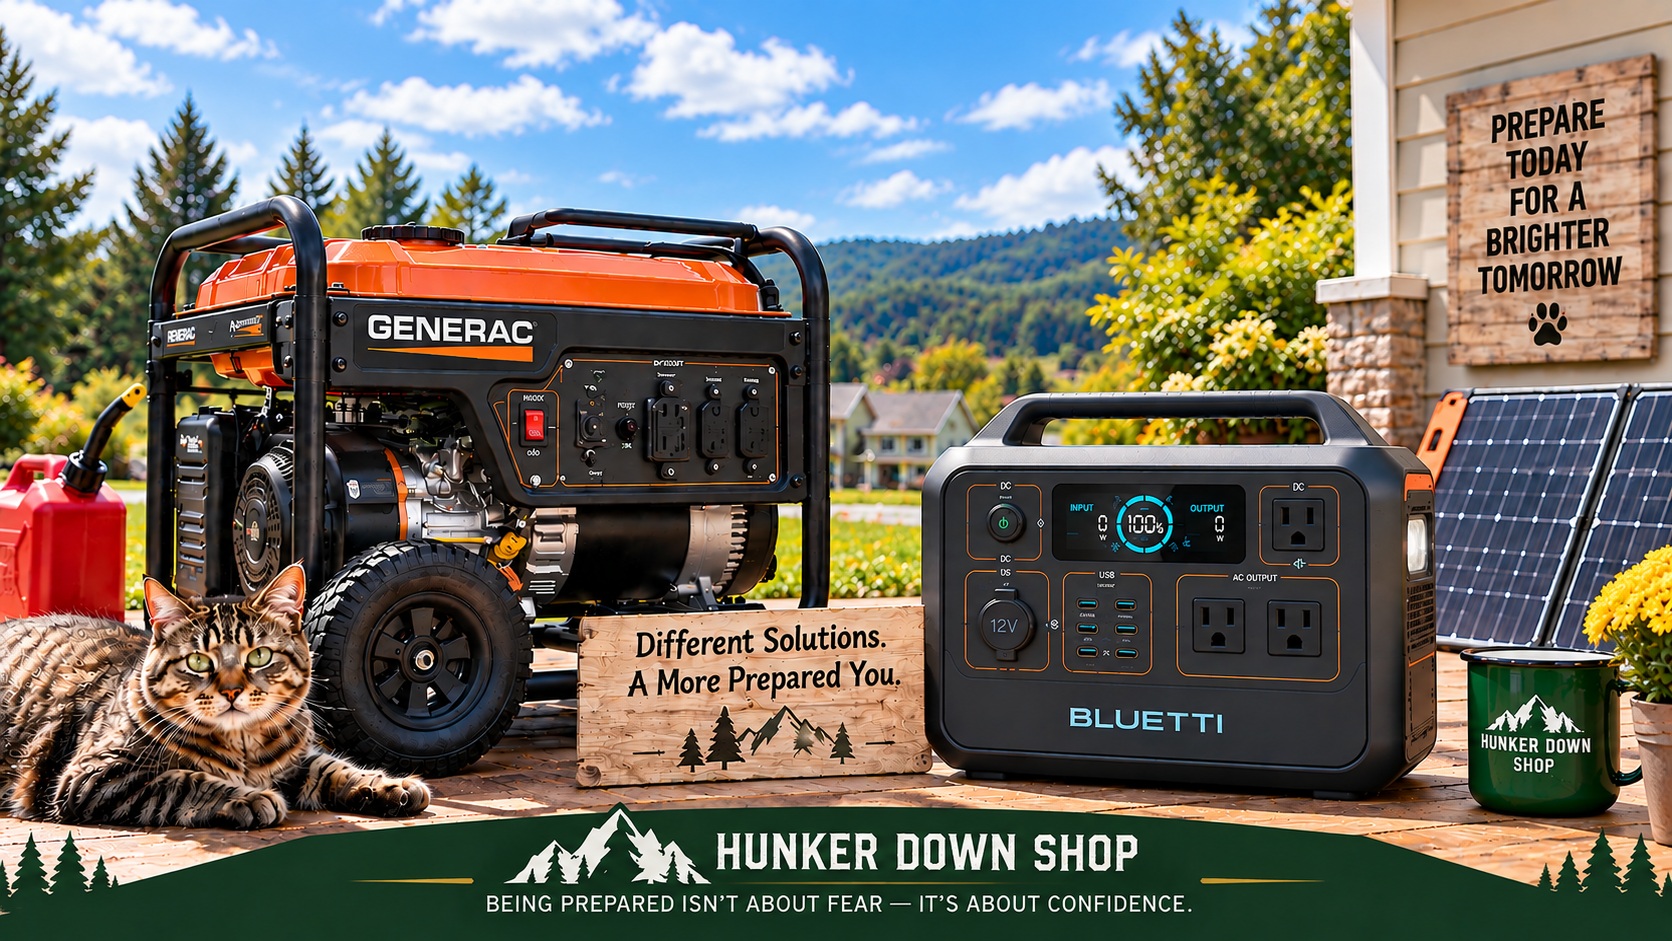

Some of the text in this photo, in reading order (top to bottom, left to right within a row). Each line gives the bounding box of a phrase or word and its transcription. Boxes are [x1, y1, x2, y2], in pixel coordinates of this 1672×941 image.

[1491, 98, 1606, 144] PREPARE
[1506, 140, 1589, 180] TODAY
[1510, 180, 1587, 217] FOR A
[1486, 217, 1610, 257] BRIGHTER
[1478, 255, 1623, 295] TOMORROW
[367, 314, 534, 344] GENERAC
[1069, 503, 1094, 512] INPUT
[1190, 504, 1225, 513] OUTPUT
[1127, 514, 1164, 534] 100%
[1232, 573, 1278, 582] AC OUTPUT
[990, 618, 1018, 634] 12V
[636, 624, 886, 659] Different Solutions.
[627, 660, 901, 700] A More Prepared You.
[1069, 707, 1223, 734] BLUETTI
[1481, 733, 1591, 753] HUNKER DOWN
[1513, 756, 1555, 774] SHOP
